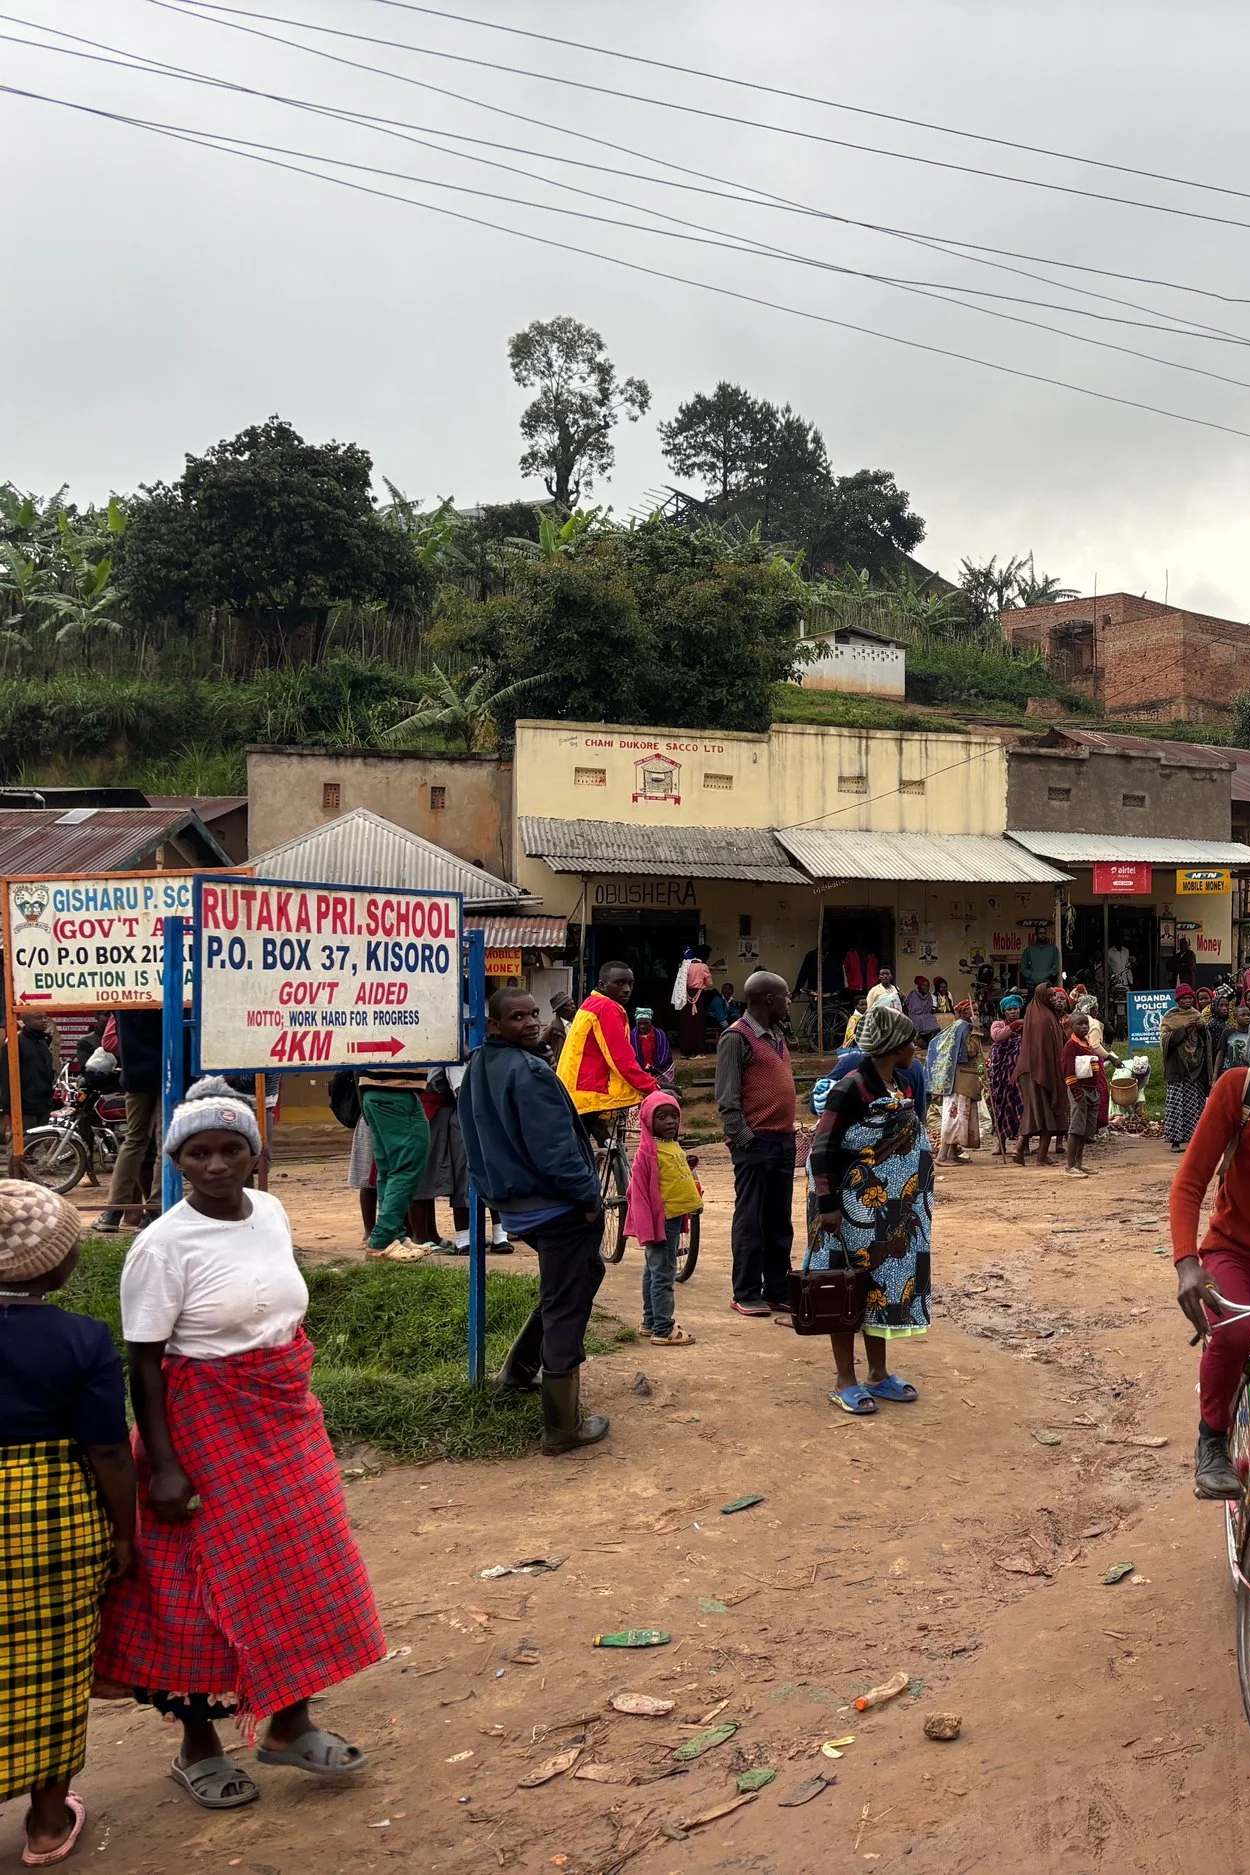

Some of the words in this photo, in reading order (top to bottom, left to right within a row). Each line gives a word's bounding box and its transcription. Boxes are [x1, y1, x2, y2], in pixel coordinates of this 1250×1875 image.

[585, 738, 614, 748] CHAHI
[620, 740, 660, 750] DUKORE
[666, 742, 698, 752] SACCO
[704, 744, 724, 754] LTD
[1118, 866, 1136, 874] airtel
[596, 880, 696, 906] OBUSHERA
[1183, 881, 1202, 891] MOBILE
[1206, 880, 1224, 891] MONEY
[53, 886, 138, 912] GISHARU
[144, 884, 158, 910] P.
[163, 885, 193, 908] SC
[203, 888, 312, 934] RUTAKA
[366, 898, 456, 938] SCHOOL
[53, 916, 140, 944] (GOV'T
[993, 932, 1022, 950] Mobile
[1196, 934, 1222, 956] Money
[58, 946, 88, 966] P.O
[96, 945, 138, 964] BOX
[207, 936, 253, 970] P.O.
[262, 938, 312, 970] BOX
[320, 944, 358, 976] 37,
[366, 940, 450, 974] KISORO
[484, 950, 520, 960] MOBILE
[484, 964, 520, 973] MONEY
[34, 970, 126, 989] EDUCATION
[135, 970, 149, 987] IS
[122, 990, 152, 1000] Mtrs
[278, 981, 340, 1006] GOV'T
[354, 982, 409, 1006] AIDED
[1134, 994, 1172, 1002] UGANDA
[1136, 1002, 1168, 1010] POLICE
[289, 1010, 318, 1026] WORK
[322, 1010, 347, 1026] HARD
[350, 1010, 368, 1026] FOR
[373, 1010, 420, 1026] PROGRESS
[270, 1030, 334, 1062] 4KM
